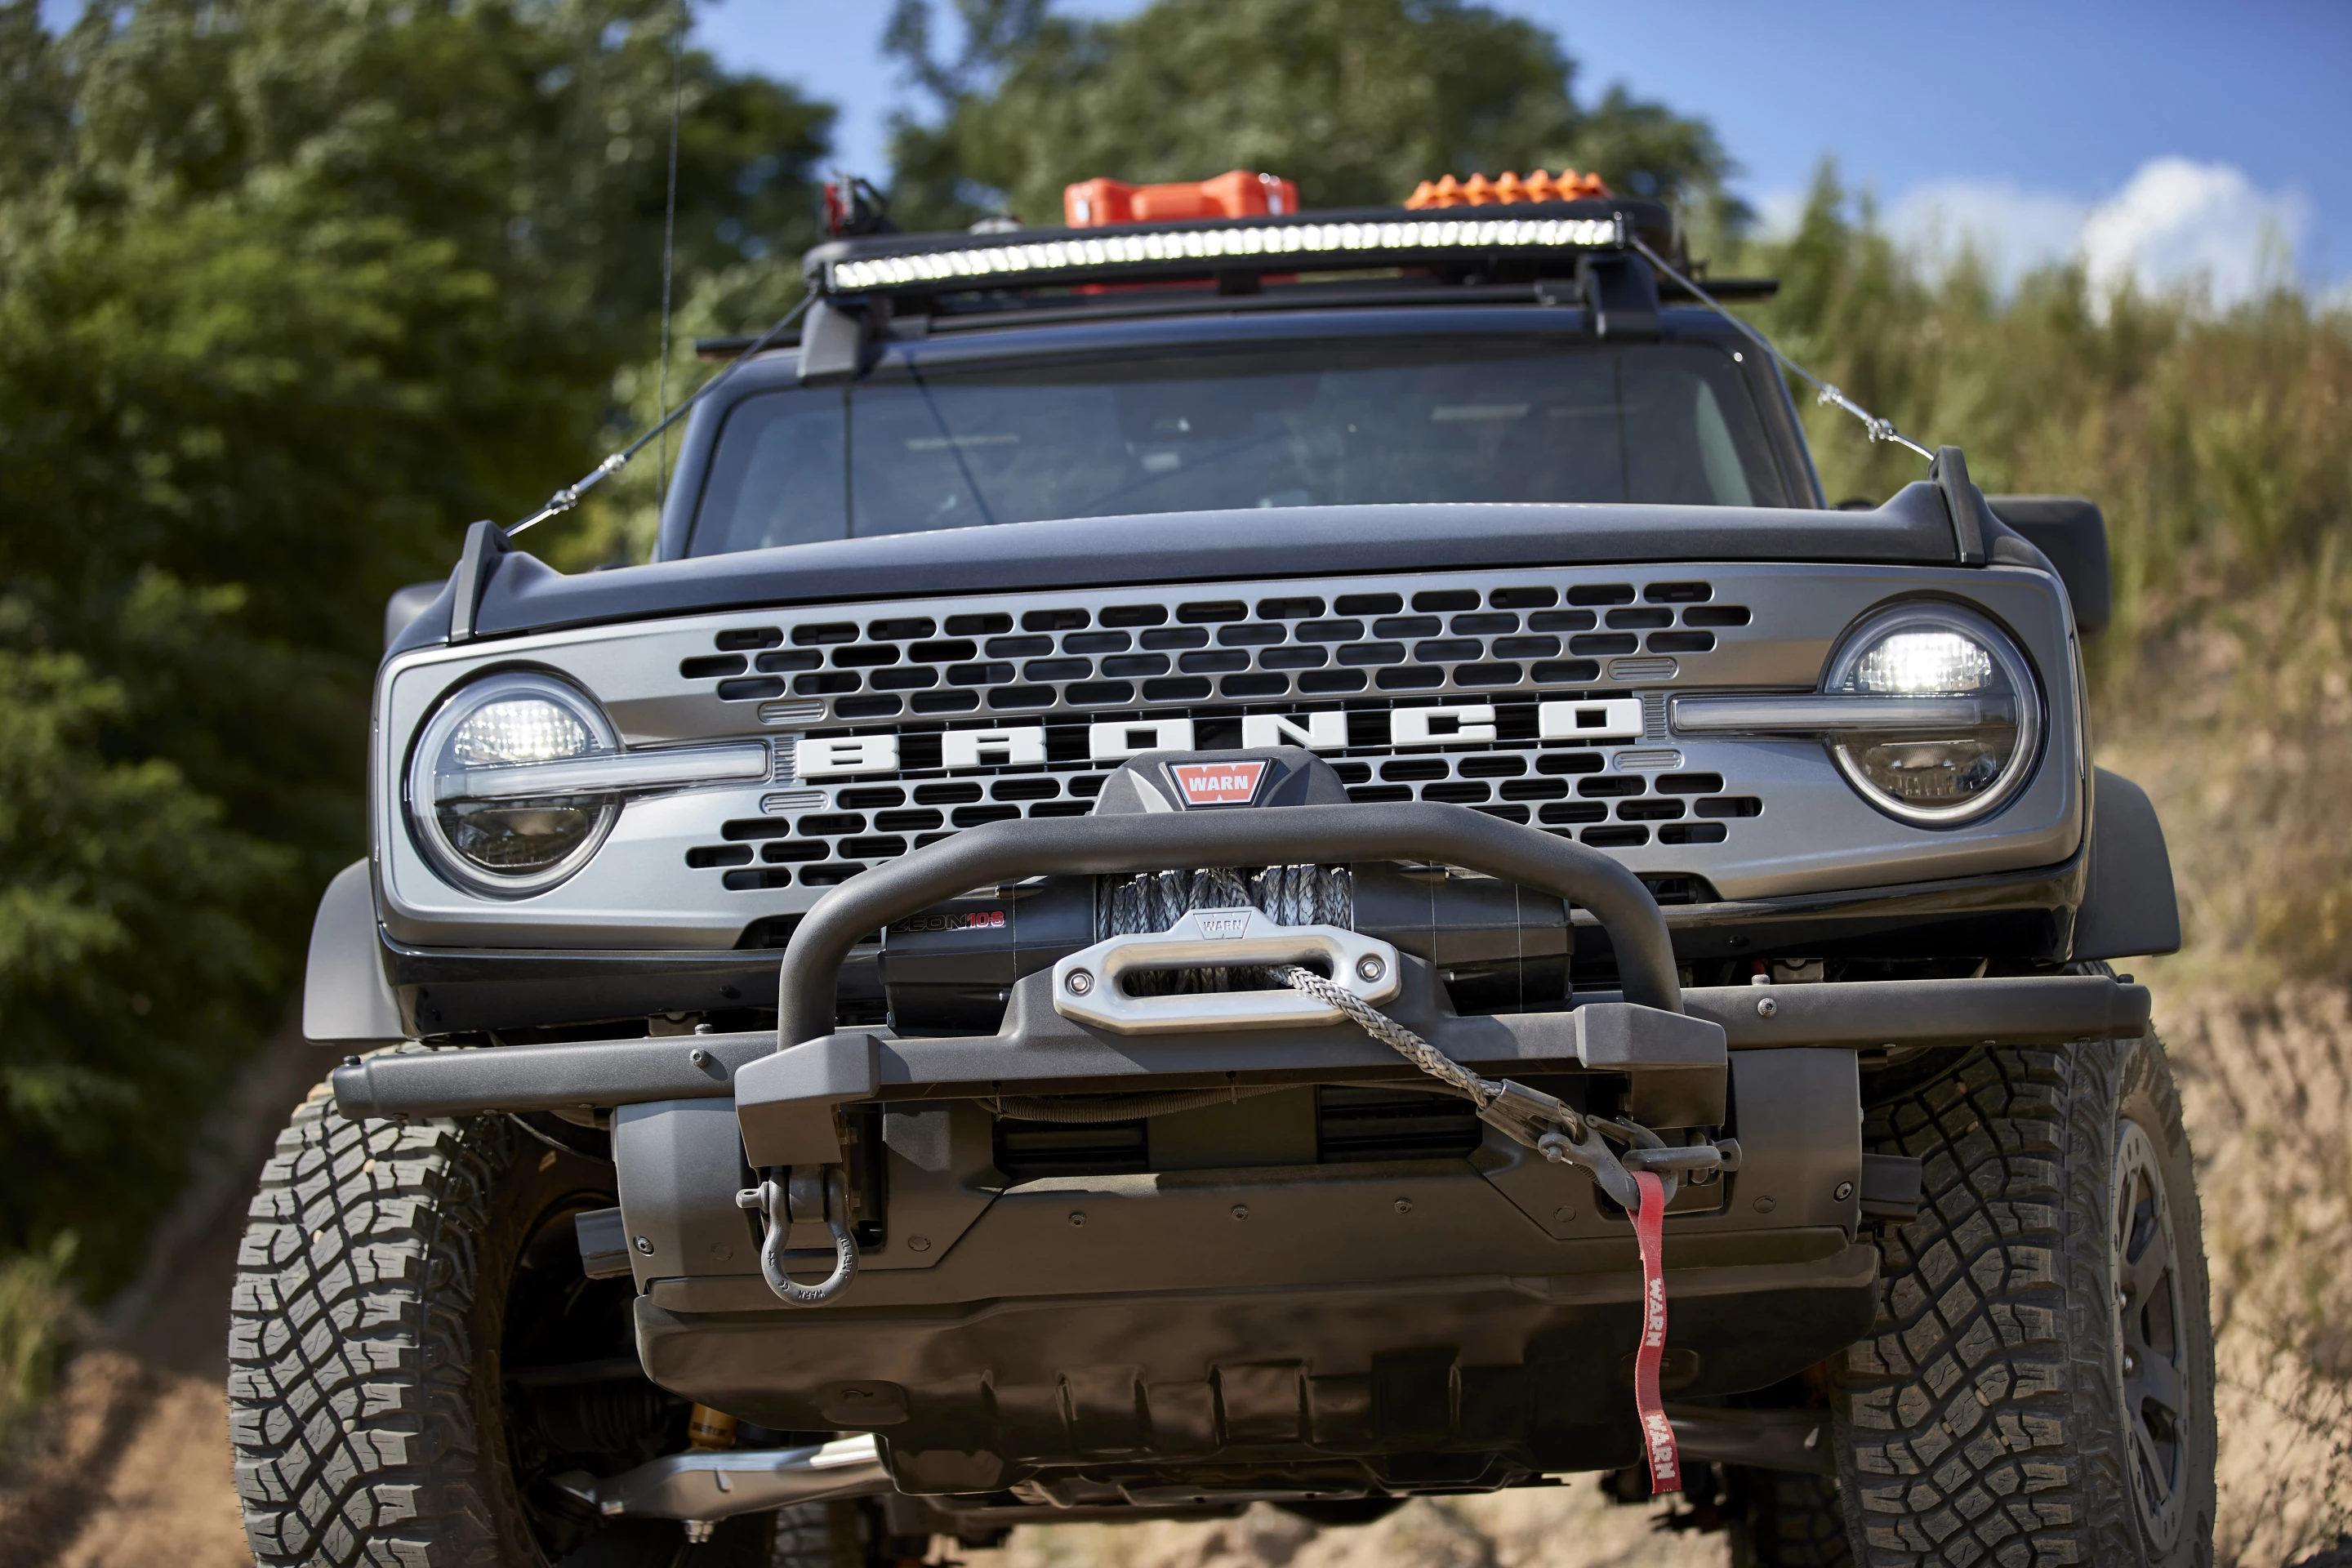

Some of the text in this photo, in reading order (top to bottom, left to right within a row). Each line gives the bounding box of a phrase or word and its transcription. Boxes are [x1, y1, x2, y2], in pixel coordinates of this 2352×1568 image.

[796, 697, 1644, 778] BRONCO
[1189, 776, 1249, 792] WARN
[1203, 920, 1242, 932] WARN
[1645, 1277, 1664, 1348] WARN
[1645, 1414, 1676, 1480] WARN
